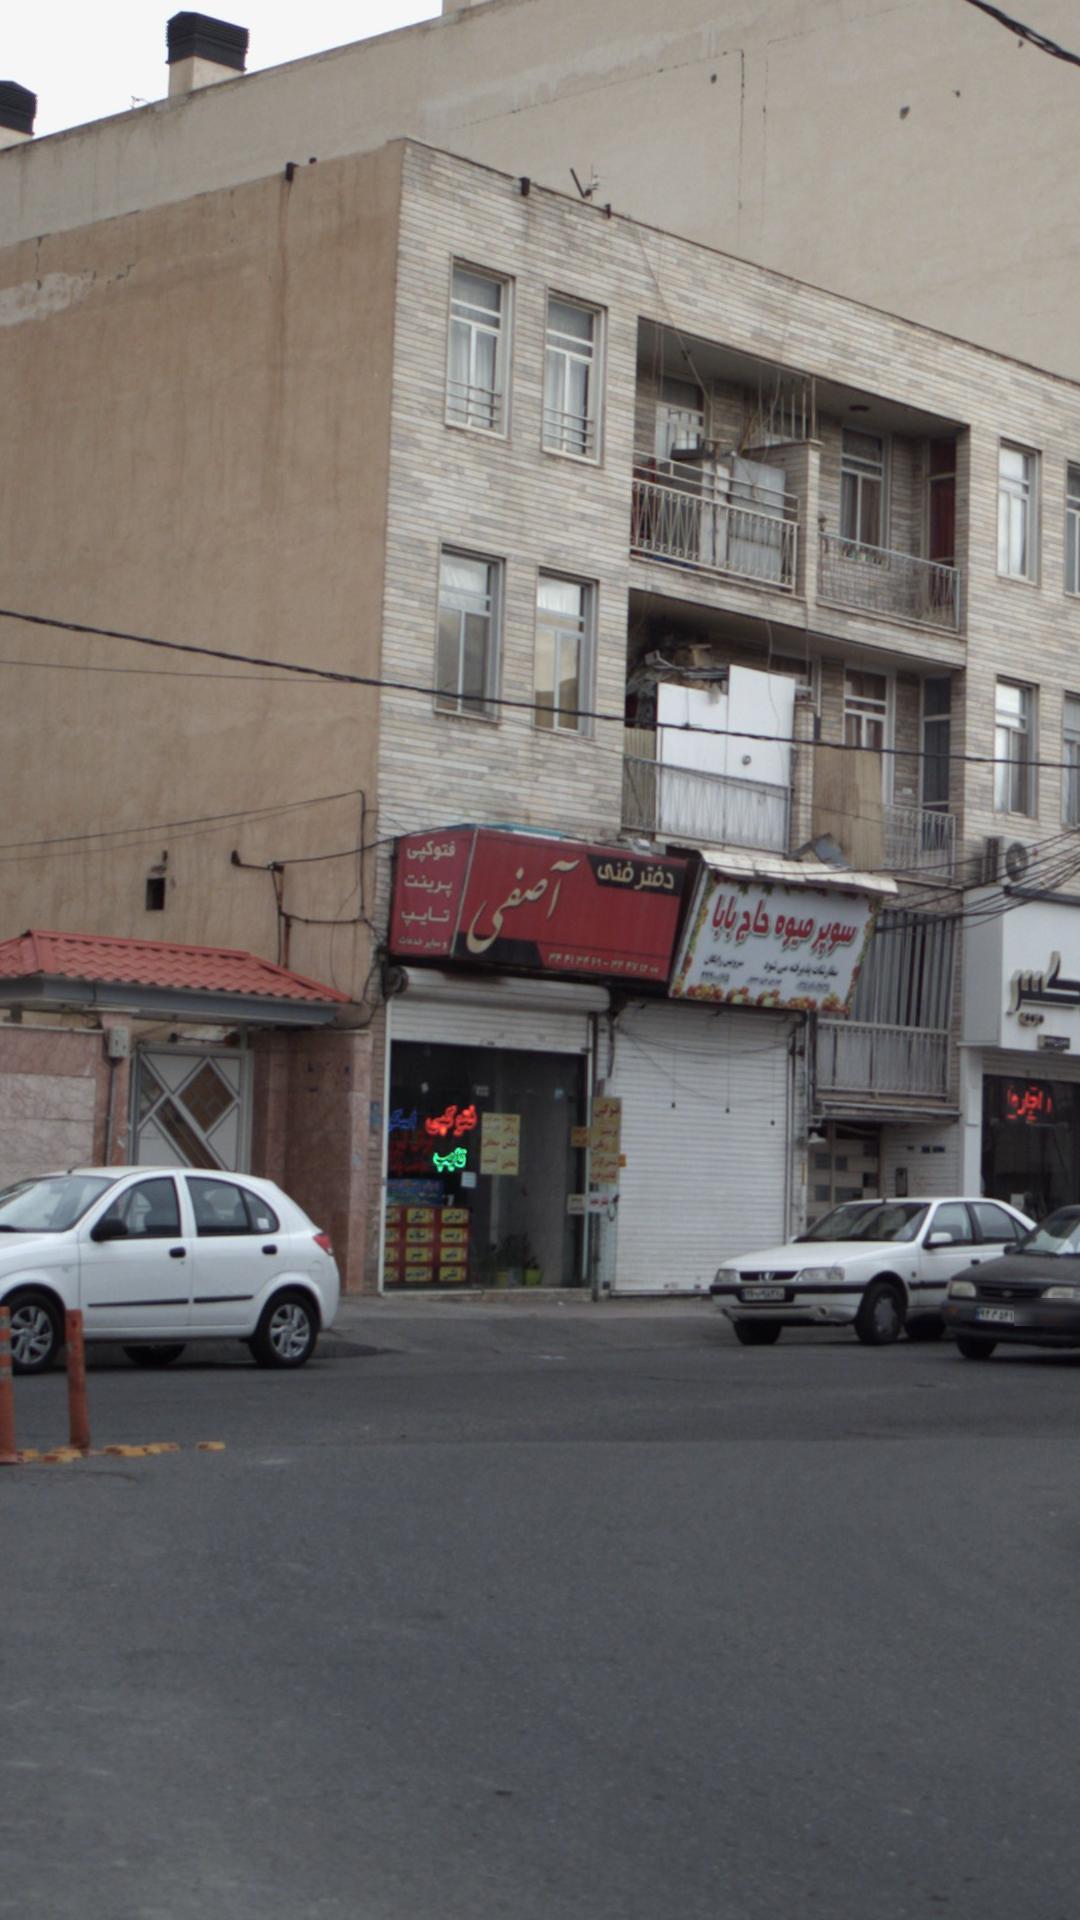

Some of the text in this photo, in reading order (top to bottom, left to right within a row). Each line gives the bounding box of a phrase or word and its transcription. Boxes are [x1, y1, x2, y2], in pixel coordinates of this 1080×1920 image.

[407, 840, 455, 860] فتوکپی
[404, 874, 453, 893] پرینت
[596, 862, 674, 890] دفتر فنی
[401, 907, 450, 926] تایپ
[466, 860, 580, 954] آصفی
[711, 894, 858, 960] سوپر میوه حاج بابا
